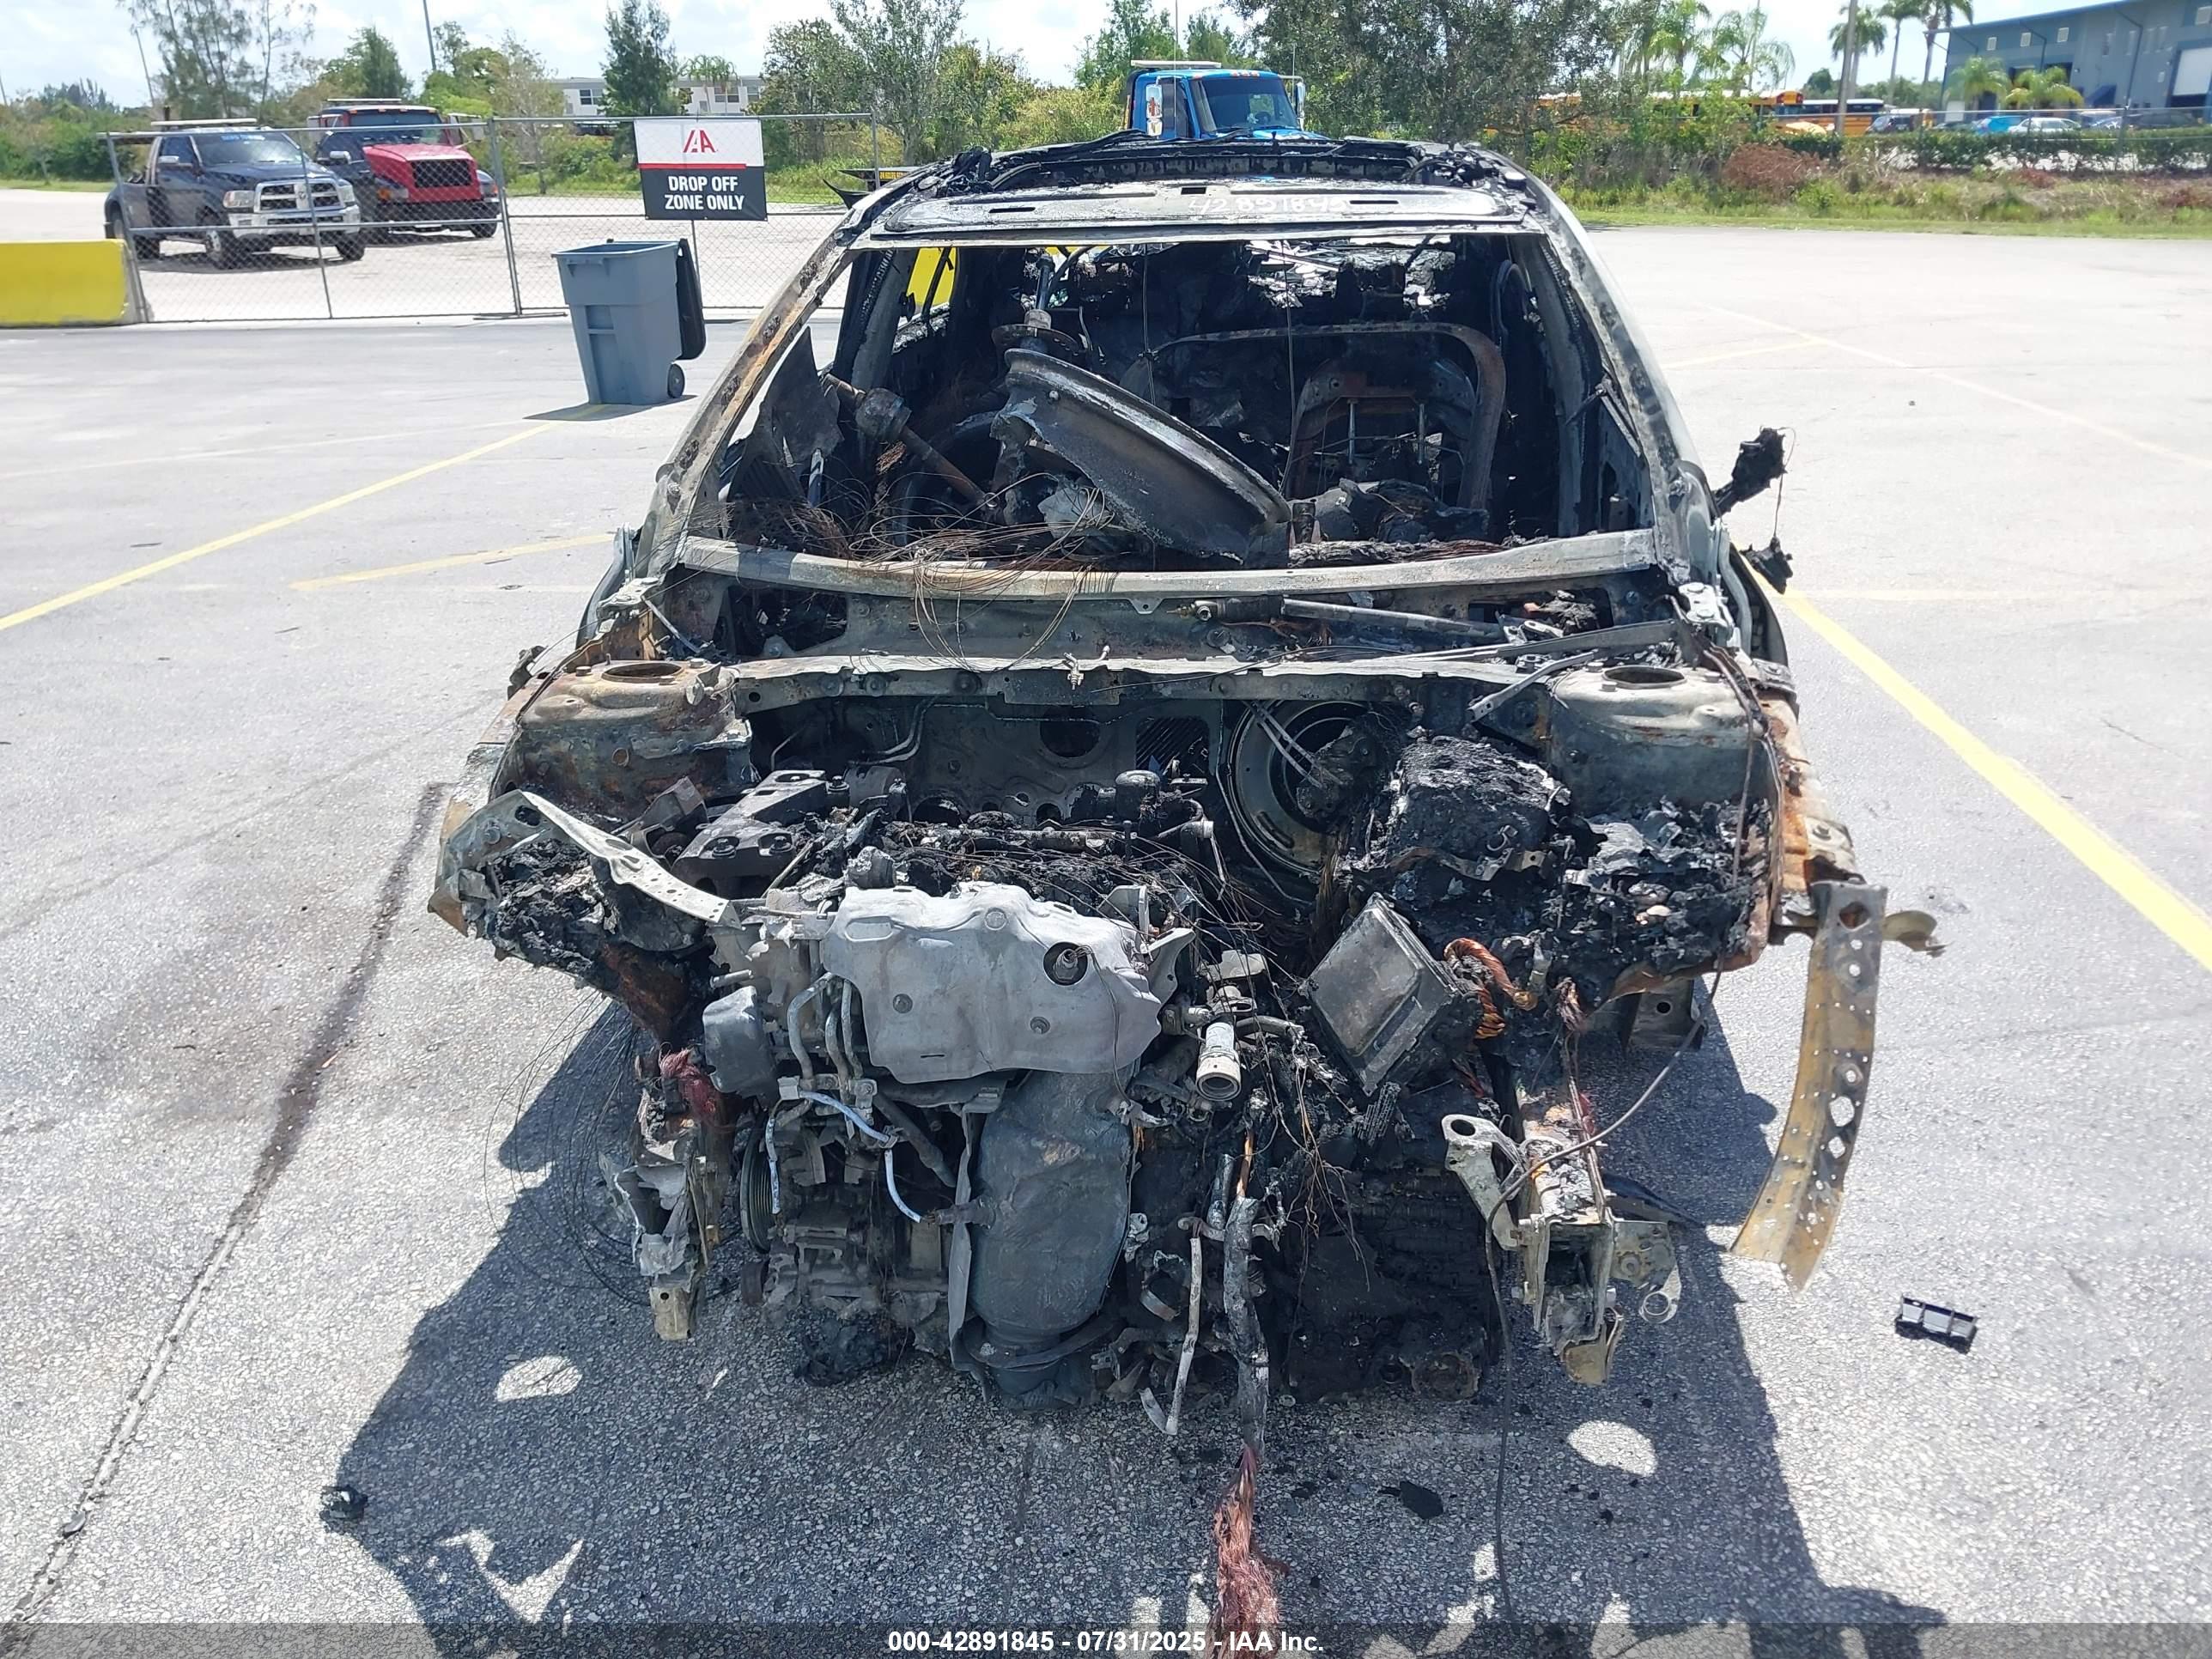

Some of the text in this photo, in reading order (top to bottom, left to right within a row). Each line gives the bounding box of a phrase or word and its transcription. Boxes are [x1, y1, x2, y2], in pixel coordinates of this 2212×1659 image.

[668, 176, 738, 191] DROP OFF
[664, 194, 744, 210] ZONE ONLY
